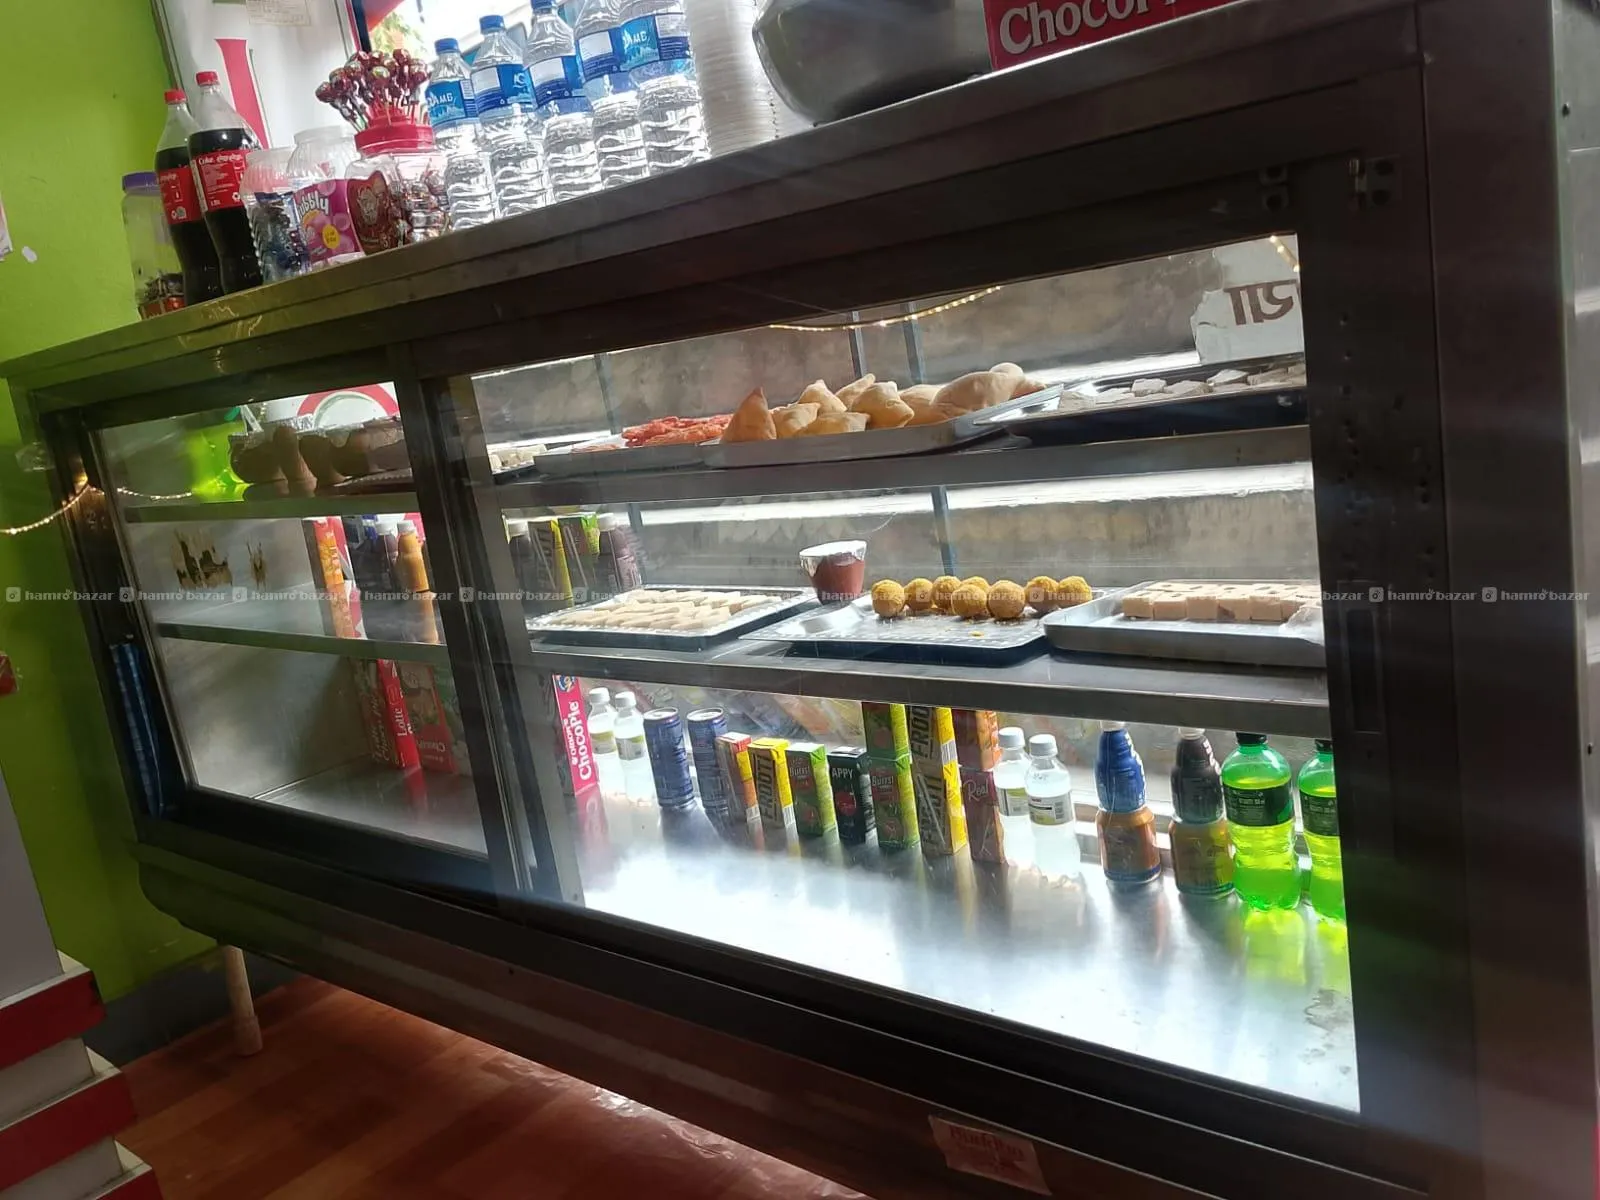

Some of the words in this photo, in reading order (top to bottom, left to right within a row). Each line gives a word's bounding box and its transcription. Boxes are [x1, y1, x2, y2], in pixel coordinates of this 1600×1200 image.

[1000, 0, 1176, 54] Choco
[911, 705, 930, 758] FROO
[832, 767, 853, 779] APPY
